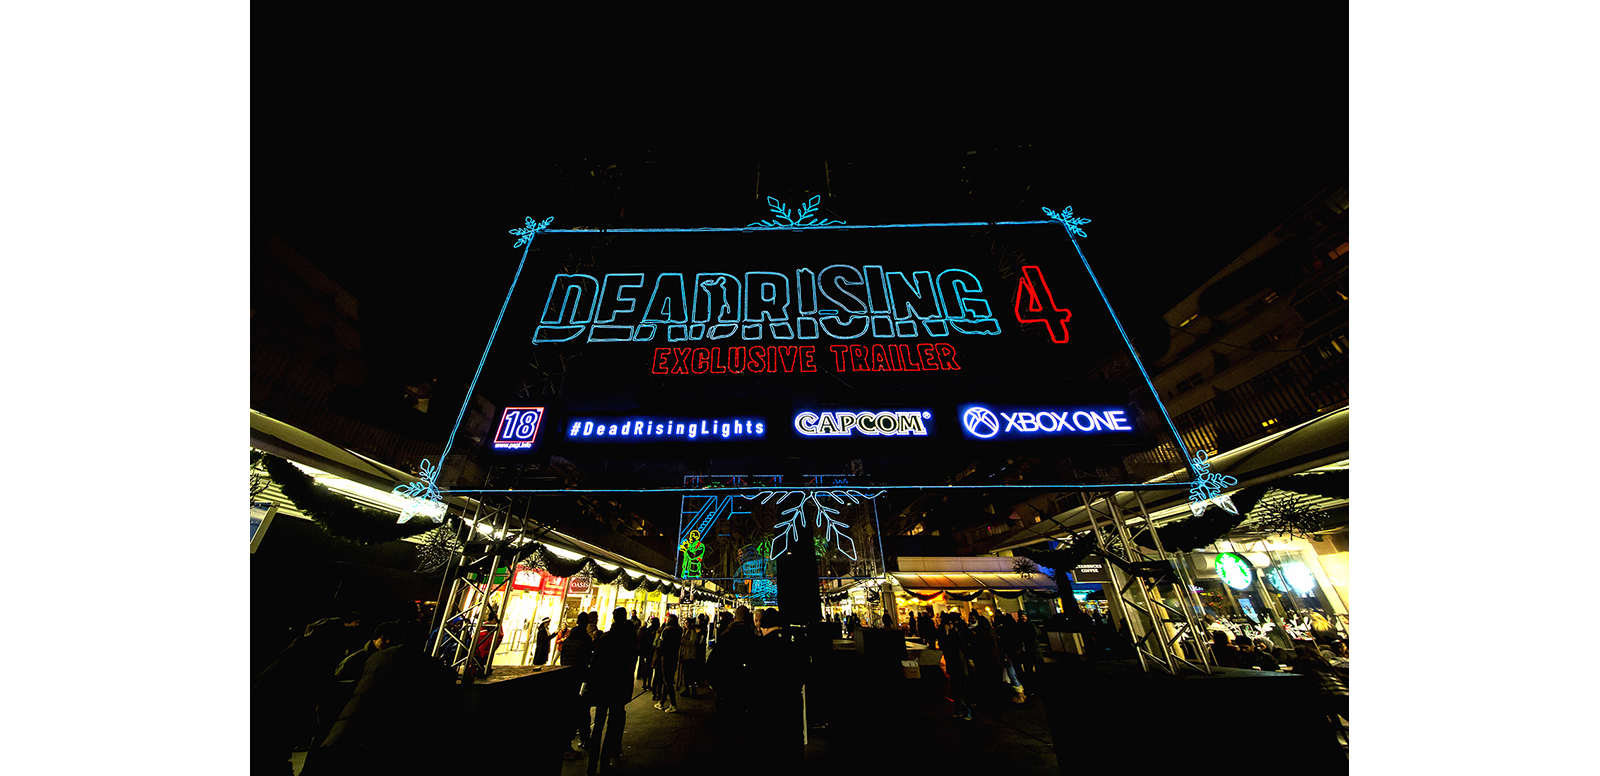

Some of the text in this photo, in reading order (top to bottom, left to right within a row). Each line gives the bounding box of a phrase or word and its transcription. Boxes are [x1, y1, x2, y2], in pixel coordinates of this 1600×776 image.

[1015, 265, 1072, 344] 4
[651, 343, 961, 374] EXCLUSIVE TRAILER
[502, 411, 539, 439] 18
[570, 419, 765, 438] #DeadRisingLights
[1004, 410, 1132, 432] XBOX ONE
